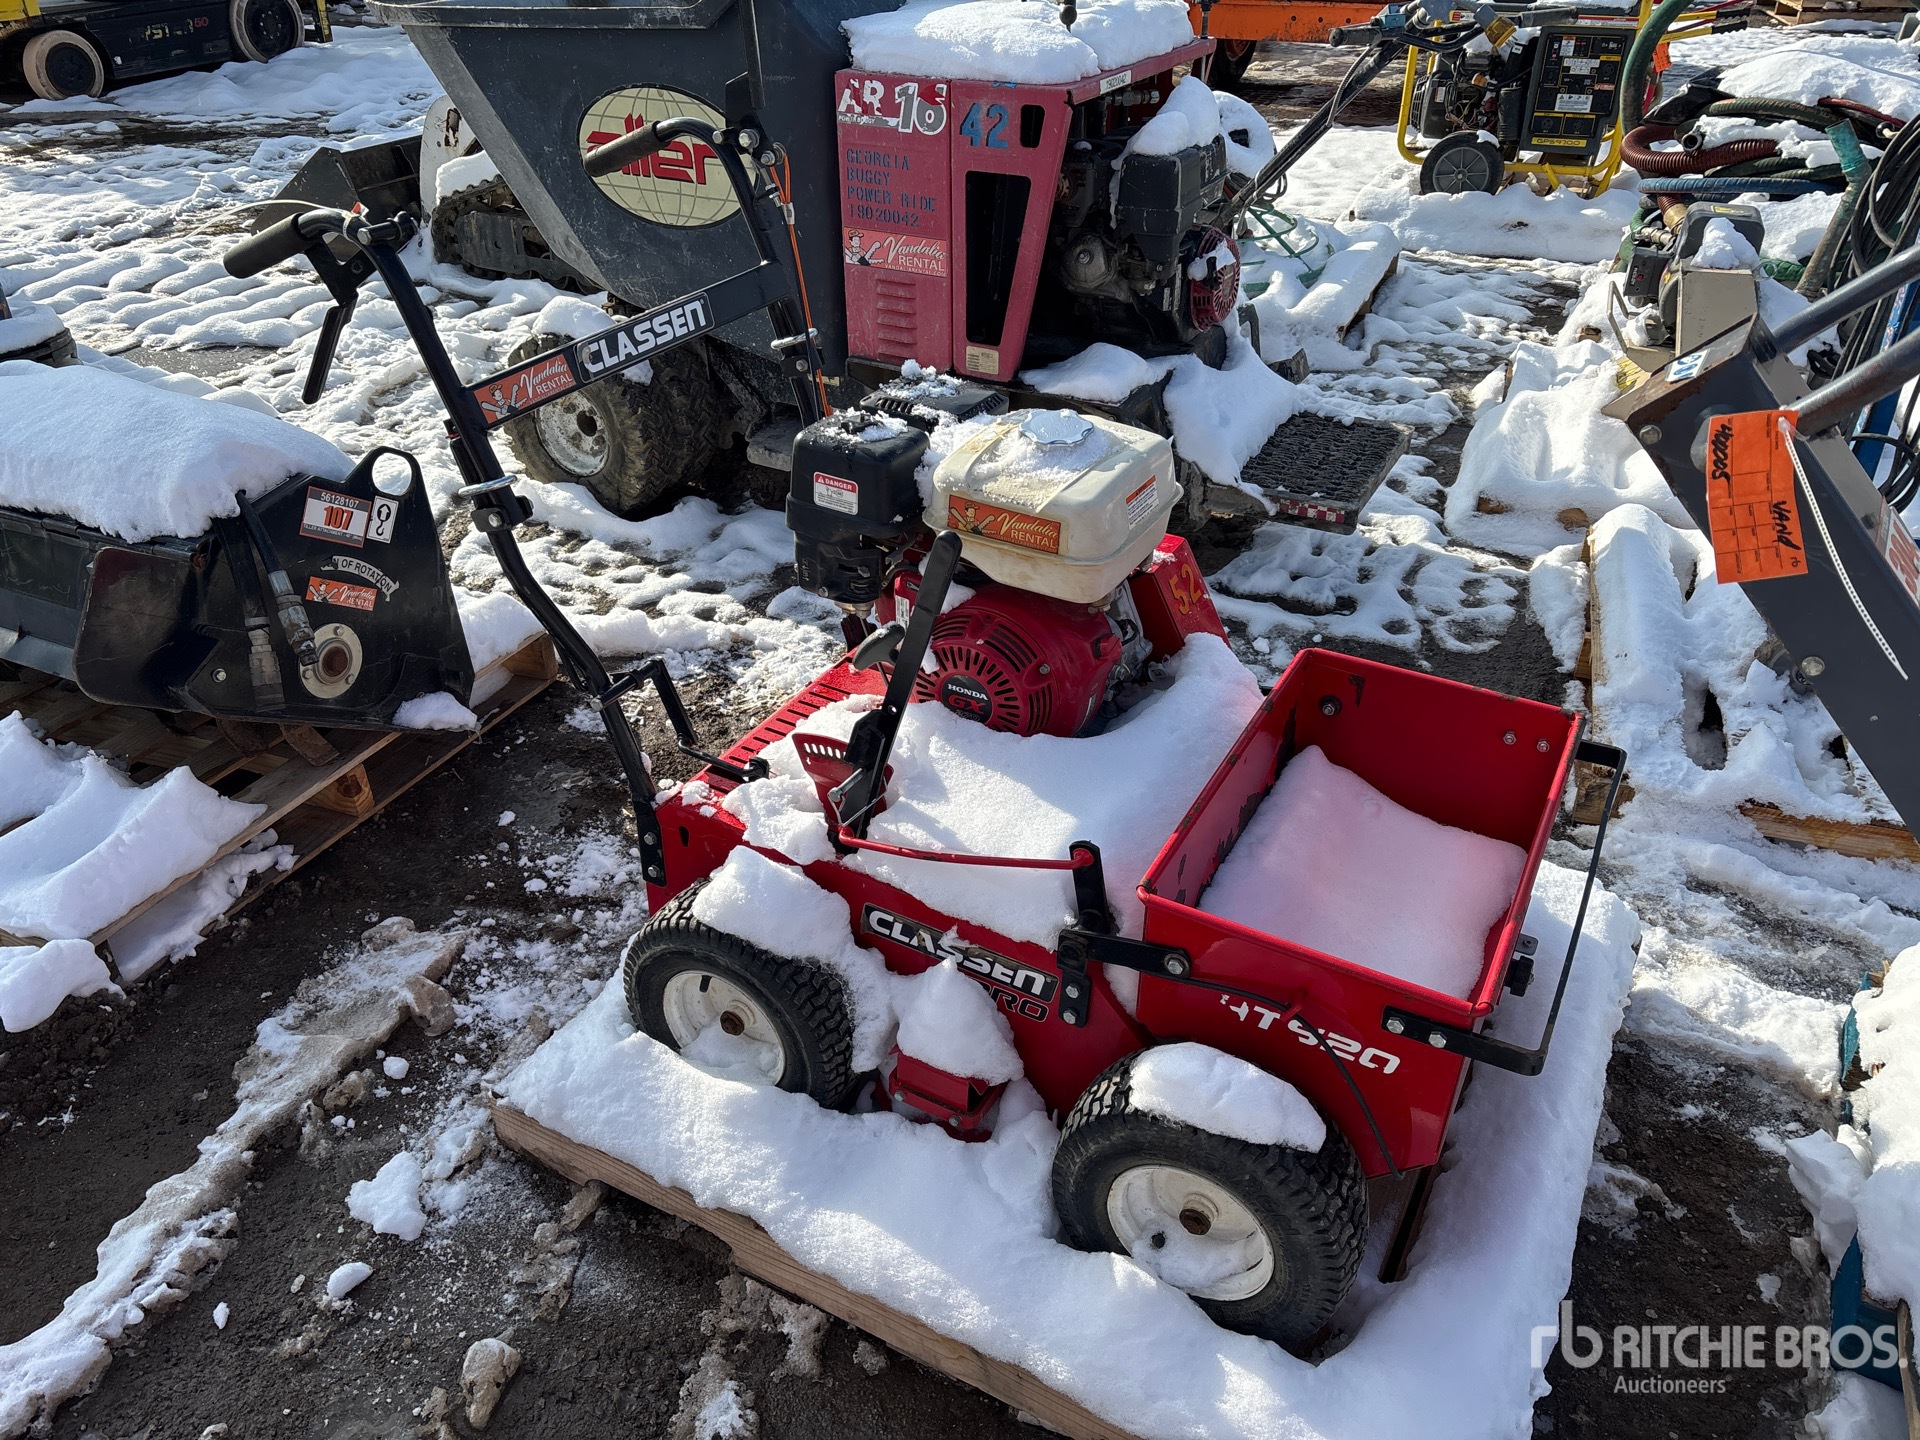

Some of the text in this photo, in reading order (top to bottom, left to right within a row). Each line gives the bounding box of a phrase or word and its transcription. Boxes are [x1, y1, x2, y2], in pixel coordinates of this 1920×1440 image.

[959, 102, 1010, 149] 42
[846, 148, 910, 171] GEORGIA
[846, 166, 890, 186] BUGGY
[847, 185, 938, 212] POWER RIDE
[850, 203, 920, 228] 19020042
[882, 235, 947, 264] Vandalia
[898, 255, 946, 272] RENTAL
[583, 299, 707, 373] CLASSEN
[520, 357, 568, 399] Vandalia
[535, 373, 573, 395] RENTAL
[825, 478, 853, 491] DANGER
[320, 492, 360, 509] 56128107
[323, 505, 354, 531] 107
[997, 512, 1058, 539] Vandalia
[1010, 529, 1056, 548] RENTAL
[341, 558, 354, 569] OF
[354, 562, 393, 593] ROTATON
[1168, 563, 1202, 615] 52
[346, 597, 374, 608] RENTAL
[947, 683, 989, 701] HONDA
[948, 694, 987, 715] GX
[968, 976, 1049, 1022] RO
